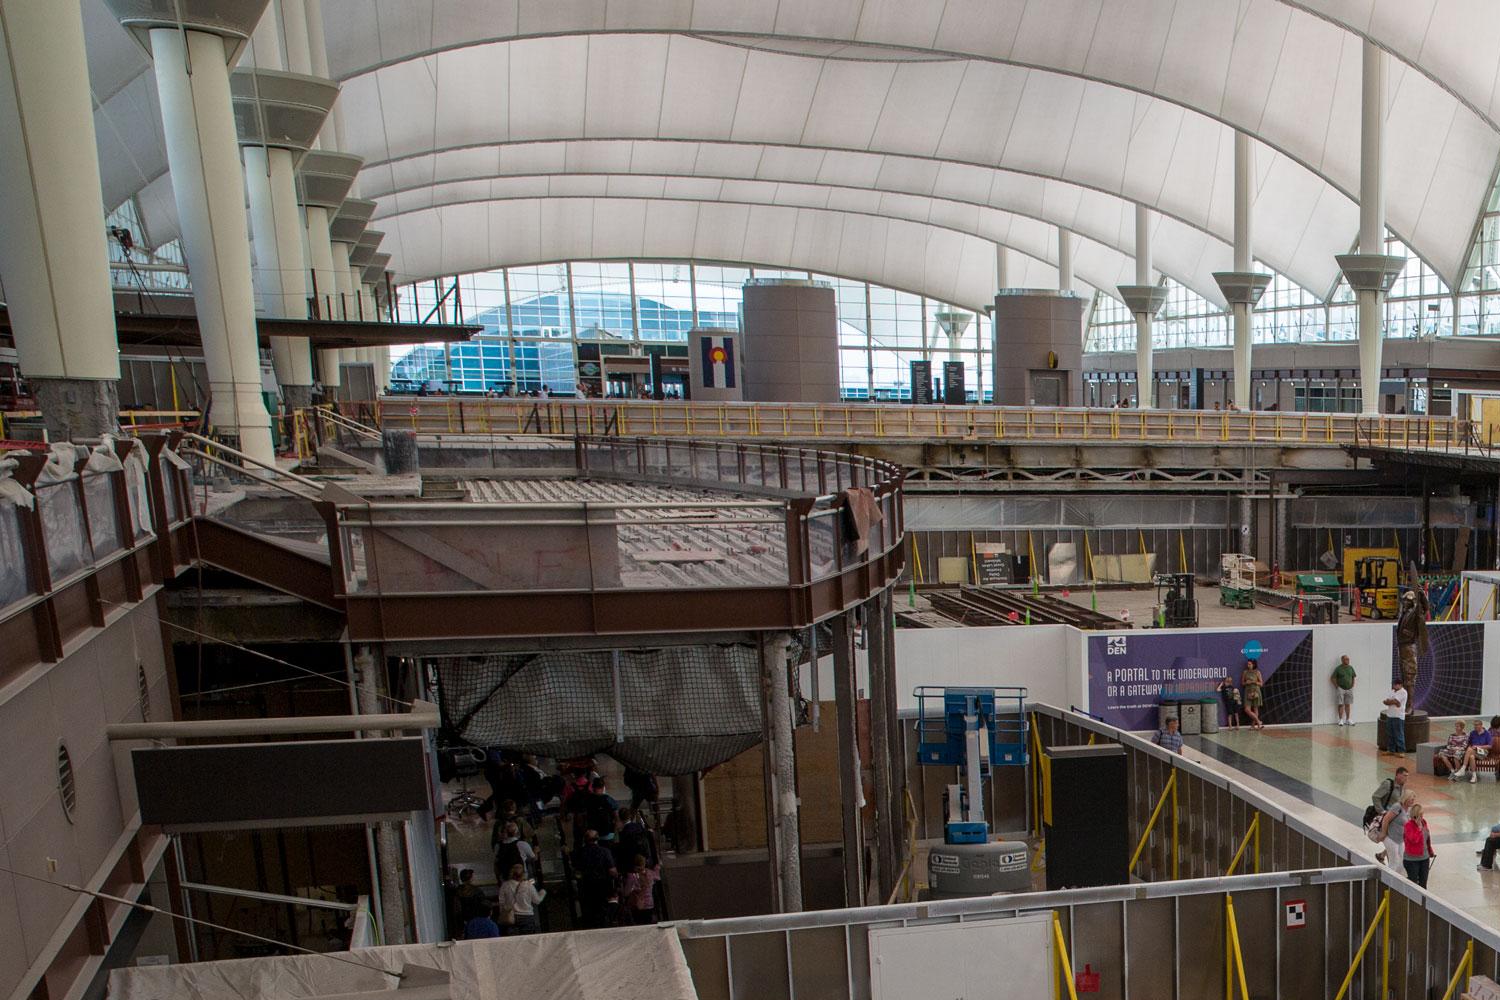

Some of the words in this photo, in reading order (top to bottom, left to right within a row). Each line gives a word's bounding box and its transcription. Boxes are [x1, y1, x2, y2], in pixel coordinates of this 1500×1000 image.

[1107, 646, 1127, 655] DEN
[1107, 671, 1113, 682] A
[1115, 668, 1149, 682] PORTAL
[1151, 669, 1161, 681] TO
[1163, 669, 1176, 680] THE
[1178, 667, 1228, 680] UNDERWORLD
[1107, 685, 1118, 697] OR
[1120, 685, 1125, 696] A
[1127, 684, 1163, 697] GATEWAY
